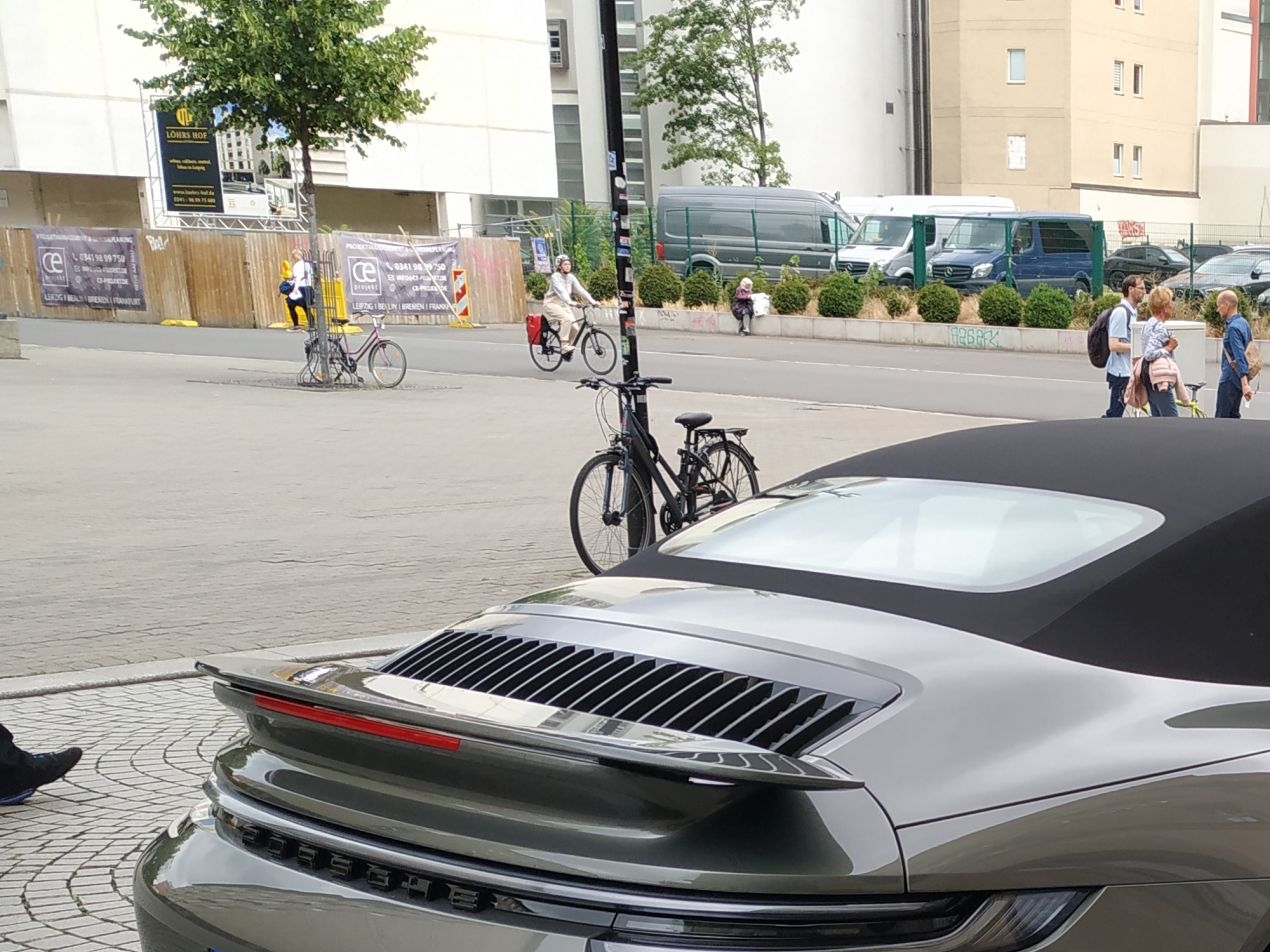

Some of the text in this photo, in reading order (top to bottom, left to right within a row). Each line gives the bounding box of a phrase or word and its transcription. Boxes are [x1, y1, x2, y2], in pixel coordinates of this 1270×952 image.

[166, 131, 191, 139] LÖHRS
[394, 263, 411, 271] 0341
[401, 303, 424, 311] BREMEN
